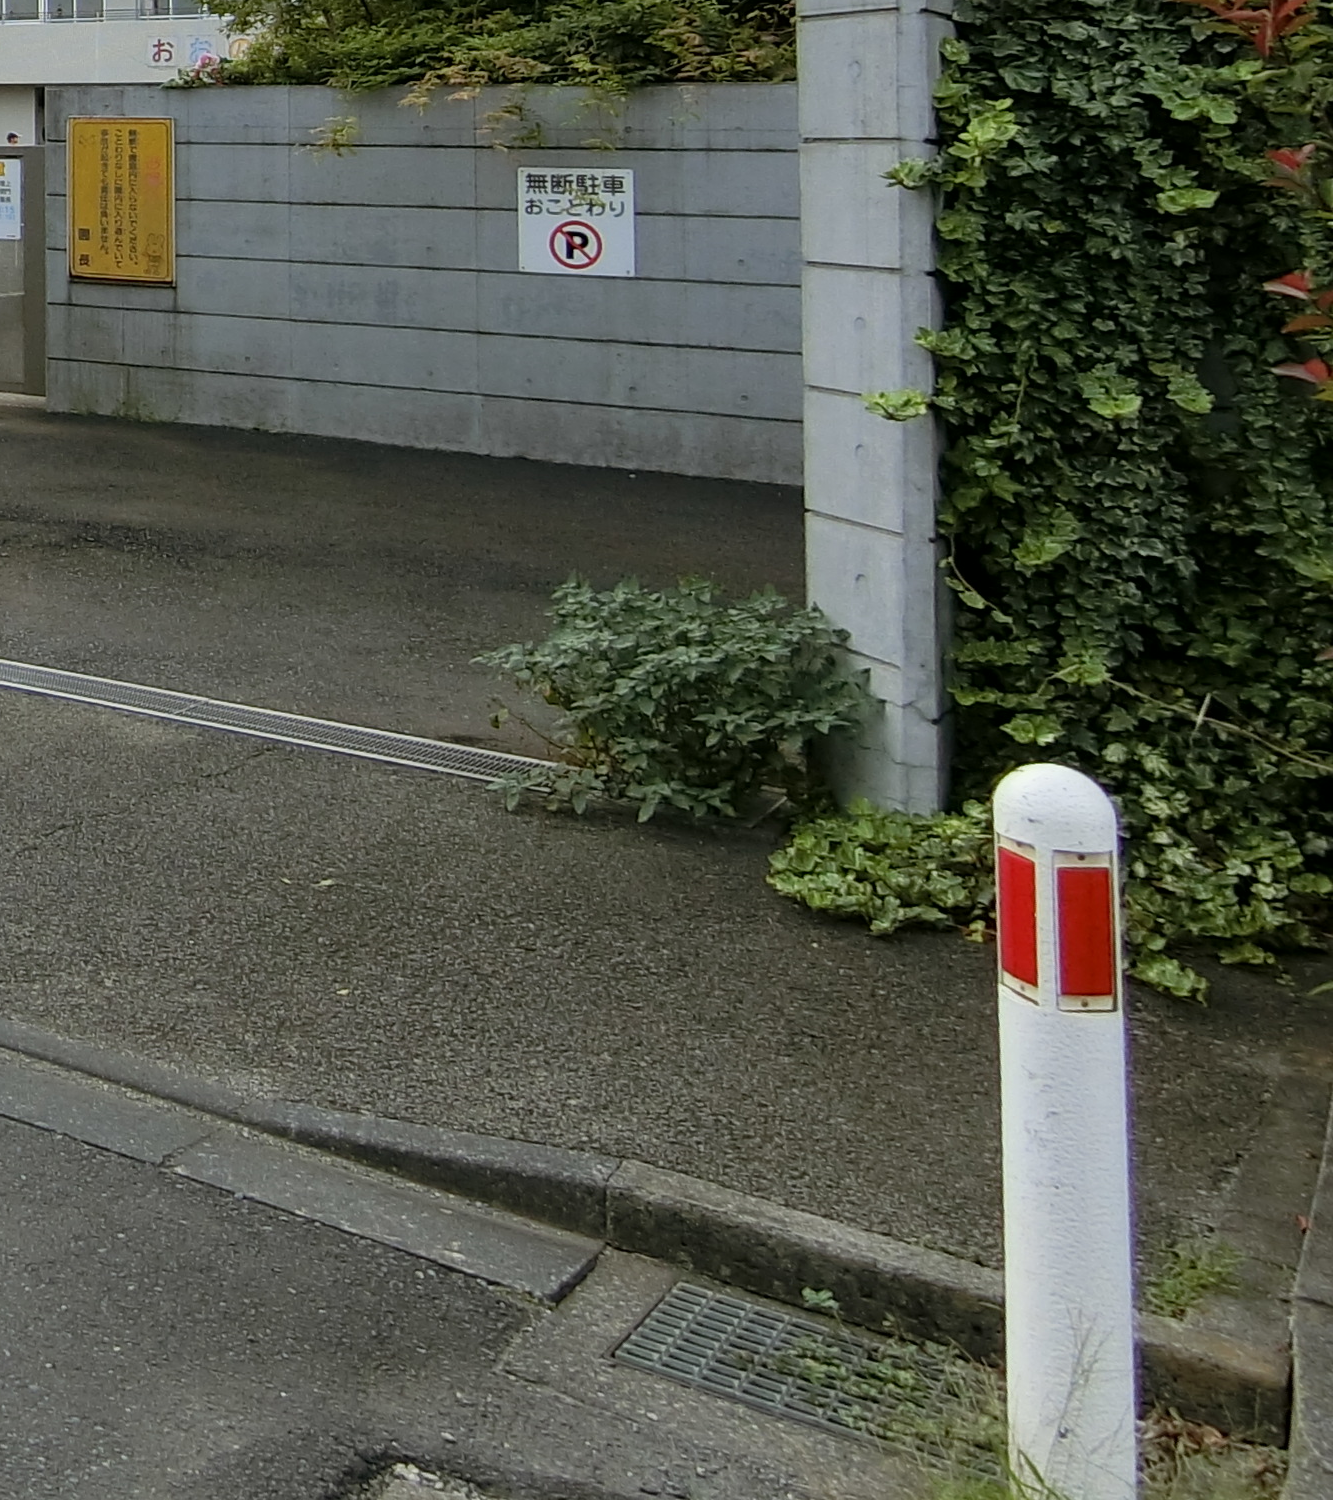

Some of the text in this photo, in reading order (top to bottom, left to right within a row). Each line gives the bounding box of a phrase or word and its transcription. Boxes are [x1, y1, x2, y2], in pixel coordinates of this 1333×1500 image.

[525, 173, 626, 196] 無断駐車
[524, 197, 625, 218] おことわり
